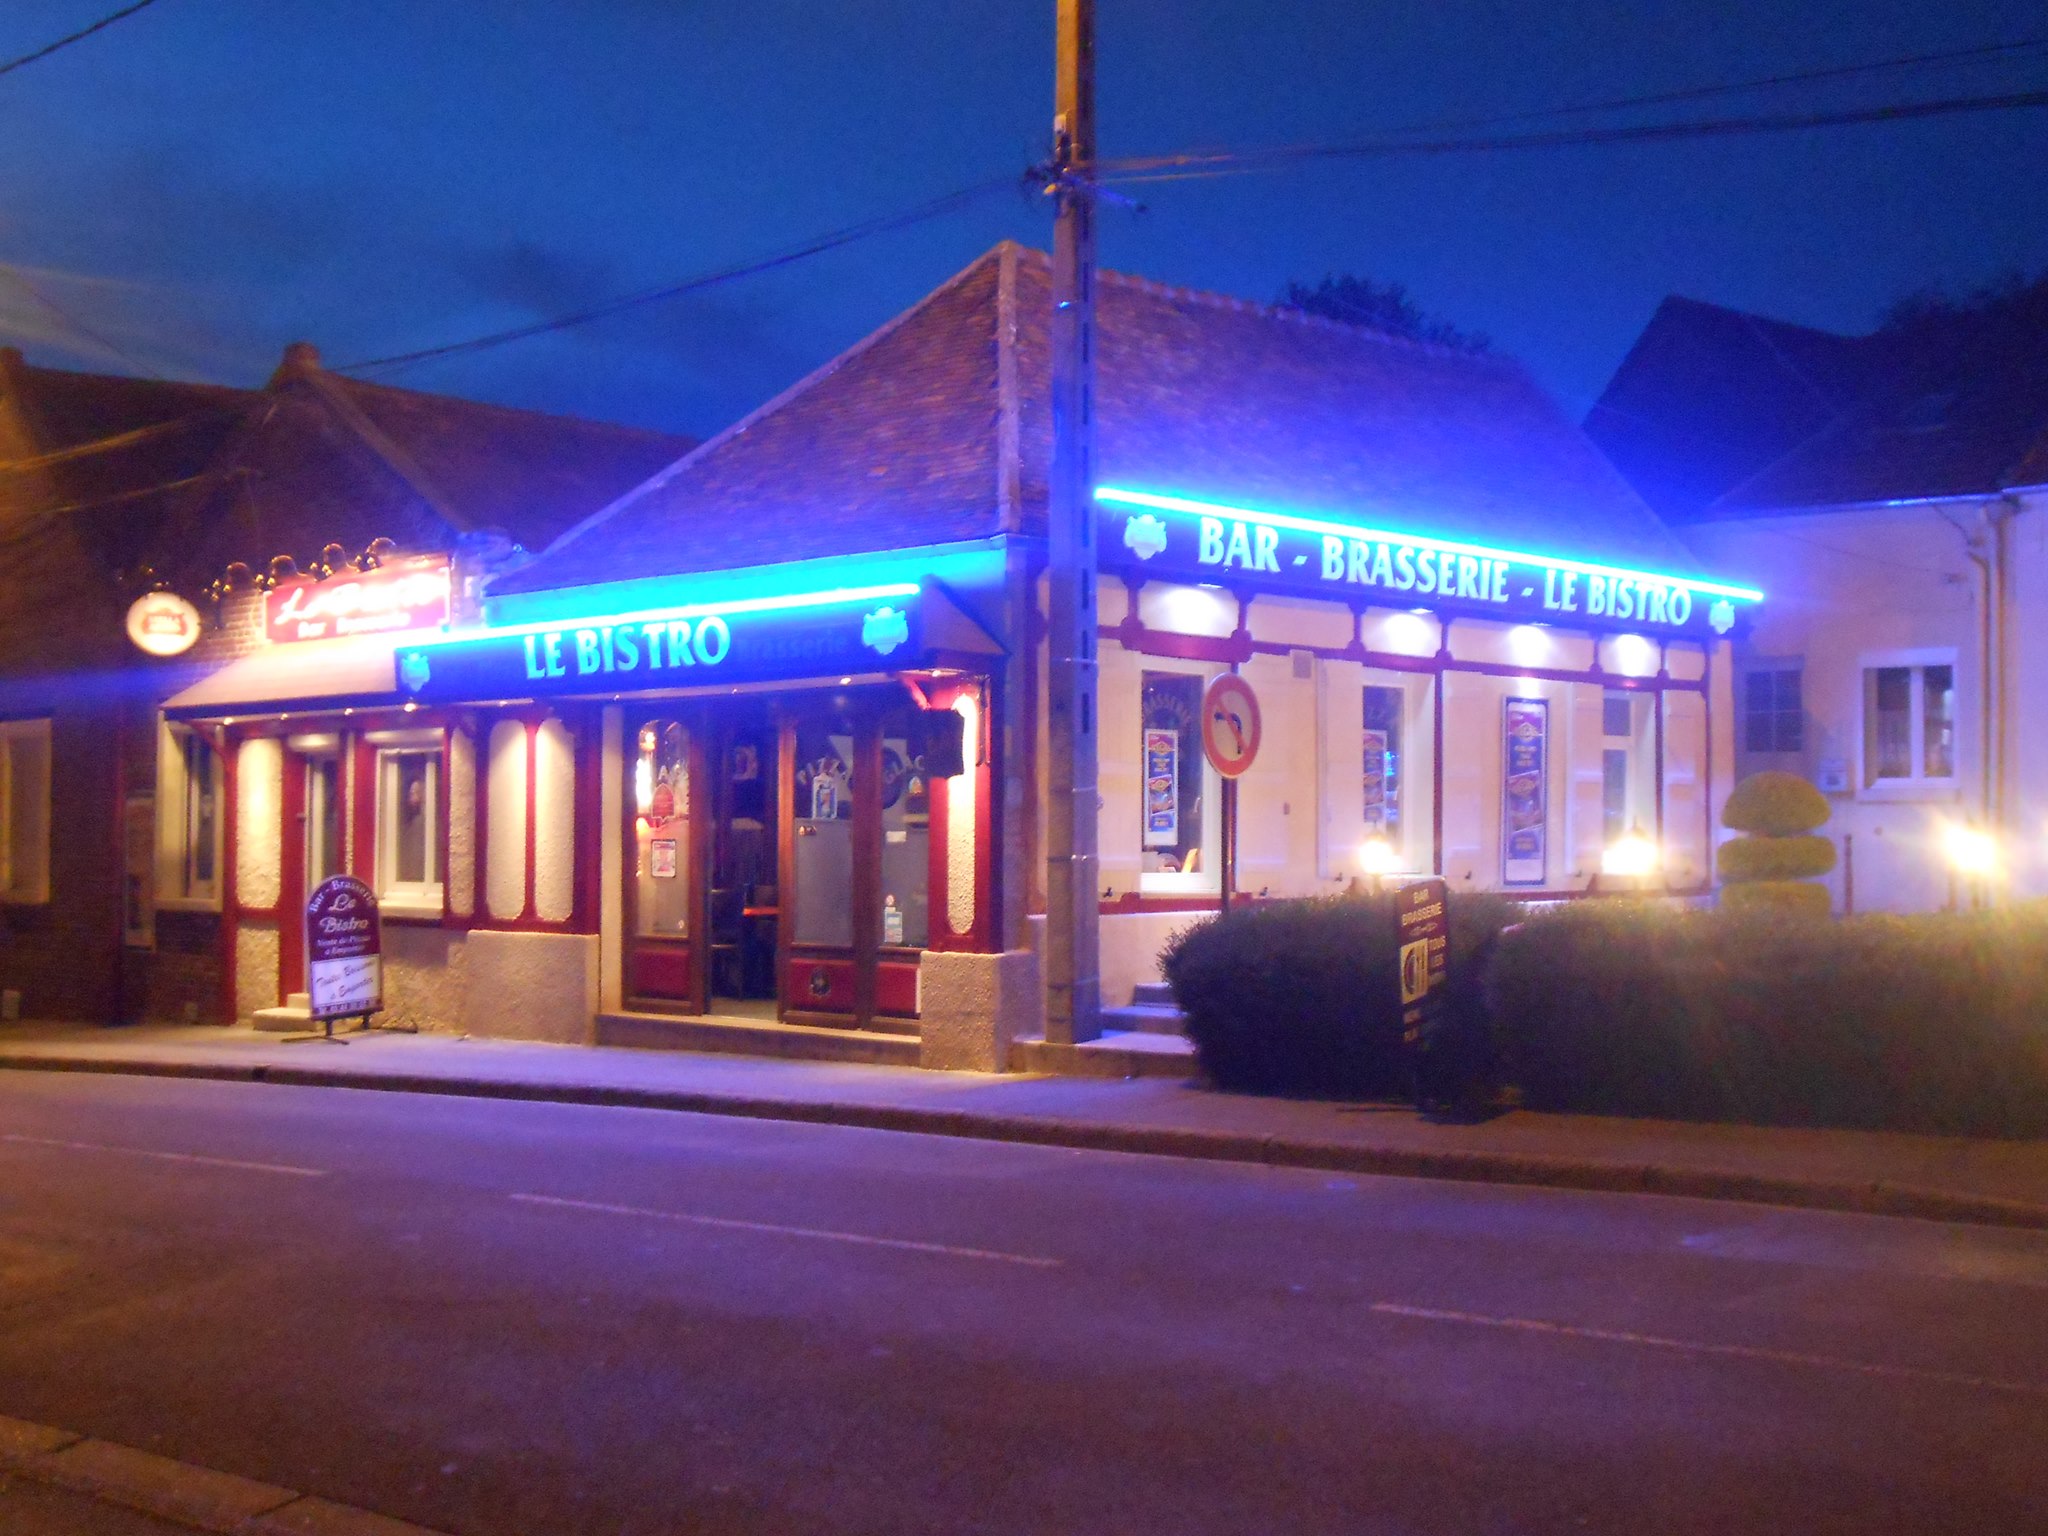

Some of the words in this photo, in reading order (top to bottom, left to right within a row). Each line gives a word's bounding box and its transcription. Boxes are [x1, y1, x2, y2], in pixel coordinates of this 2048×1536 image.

[1197, 516, 1281, 573] BAR
[1320, 534, 1510, 603] BRASSERIE
[1543, 568, 1578, 612] LE
[1586, 573, 1693, 626] BISTRO
[523, 633, 566, 680] LE
[575, 615, 731, 676] BISTRO
[308, 893, 325, 912] Bar
[331, 879, 376, 907] Brasserie
[328, 893, 357, 912] Le
[318, 916, 369, 933] Bistro
[1400, 902, 1443, 927] BRASSERIE
